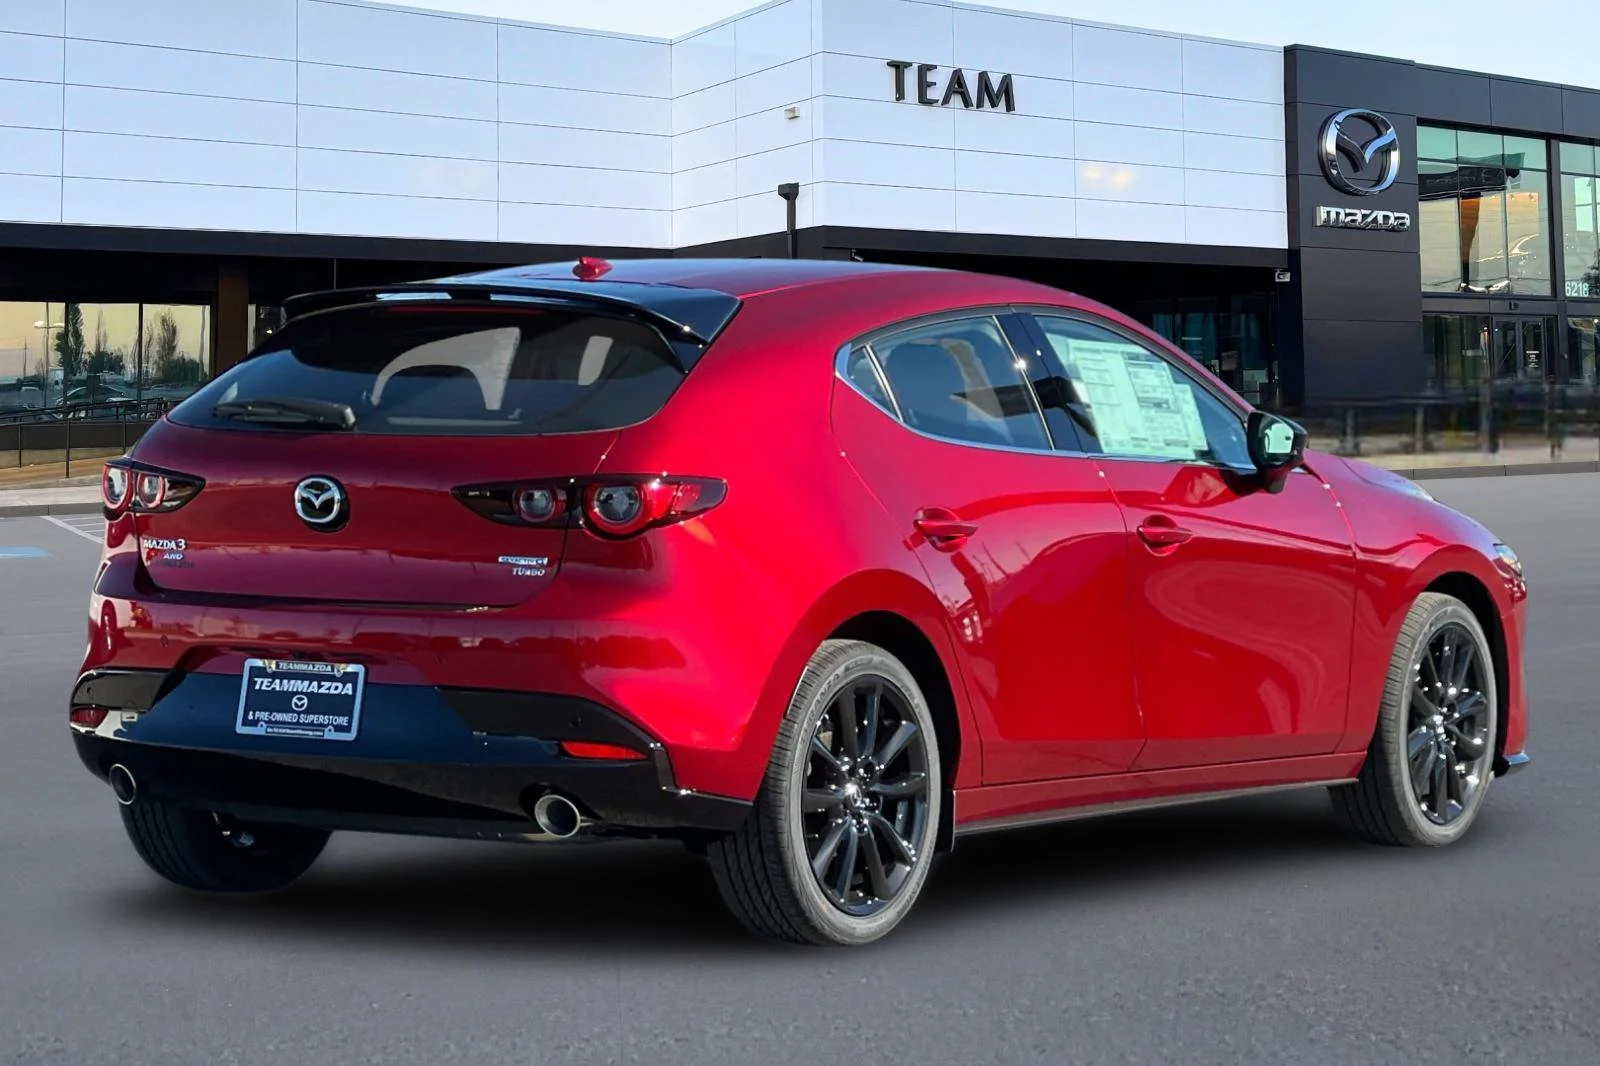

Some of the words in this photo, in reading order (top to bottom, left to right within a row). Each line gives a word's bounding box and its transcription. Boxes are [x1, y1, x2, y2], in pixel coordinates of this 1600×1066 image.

[887, 60, 1016, 112] TEAM
[1316, 206, 1410, 230] mazda
[1565, 281, 1589, 297] 6218
[278, 662, 332, 672] TEAMMAZDA
[254, 678, 352, 695] TEAMMAZDA
[248, 711, 254, 720] &
[254, 711, 298, 722] PRE-OWNED
[300, 713, 349, 726] SUPERSTORE
